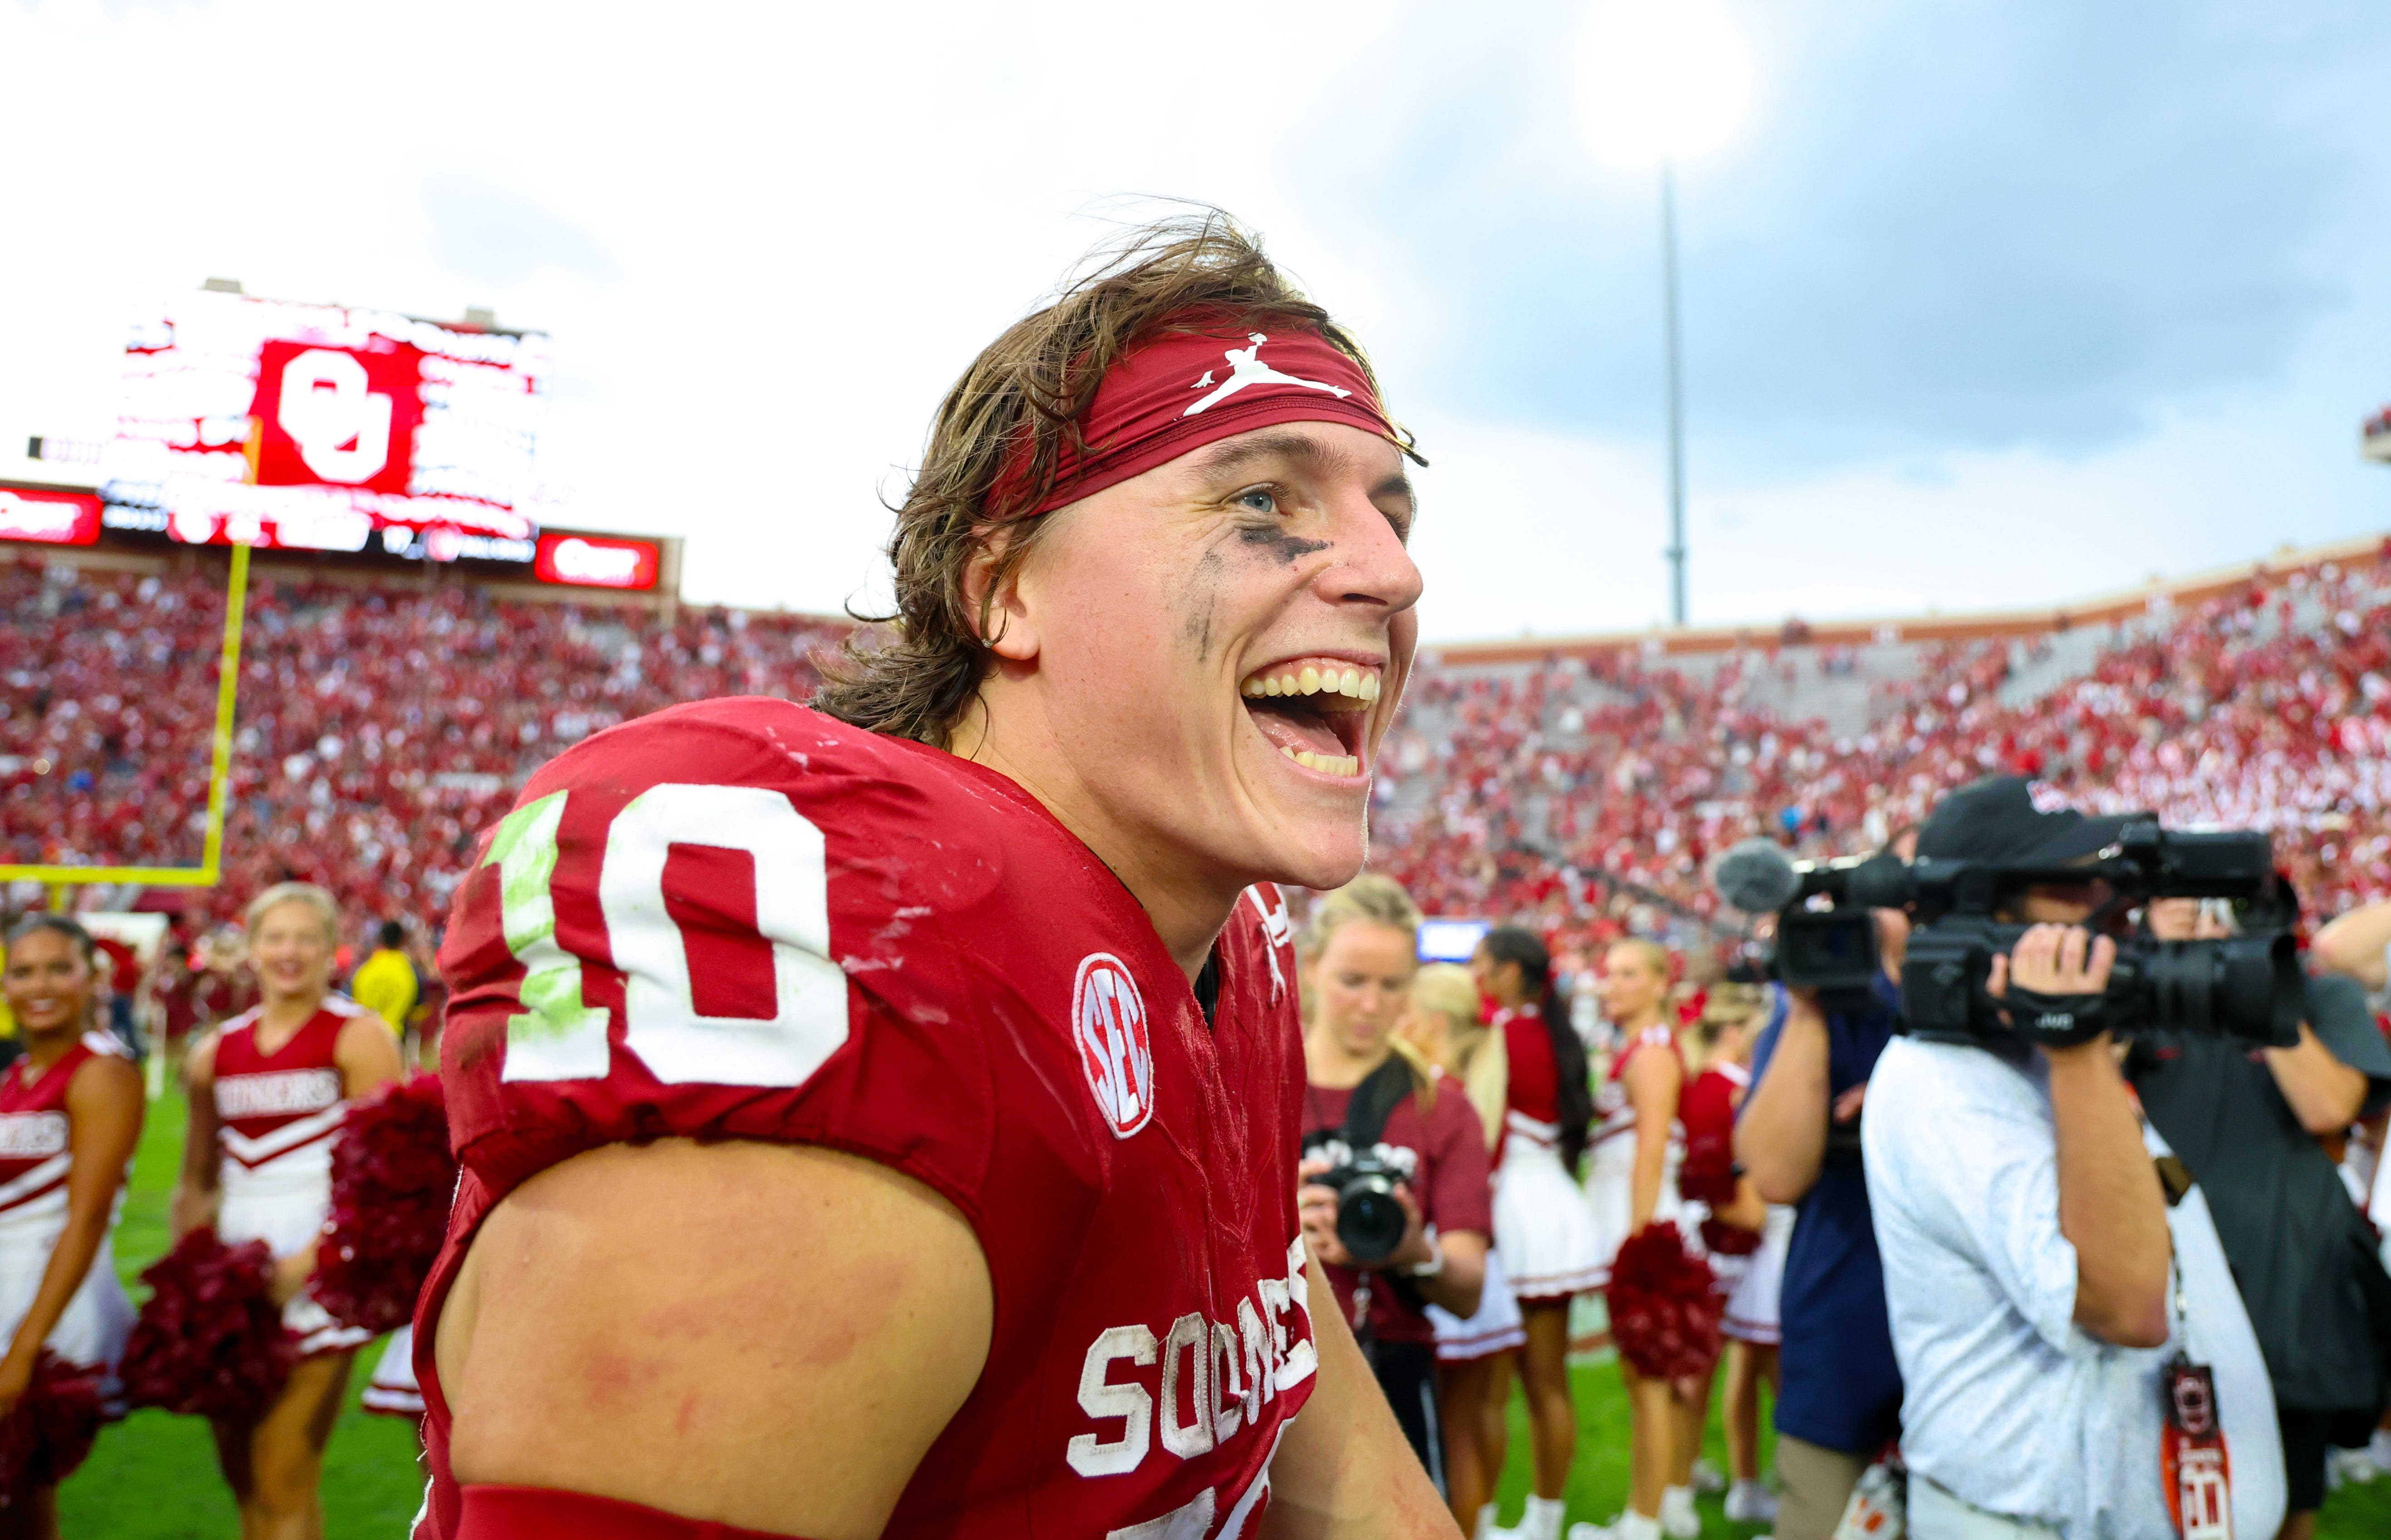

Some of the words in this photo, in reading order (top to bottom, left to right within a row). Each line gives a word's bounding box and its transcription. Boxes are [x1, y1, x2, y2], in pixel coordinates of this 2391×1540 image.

[278, 348, 393, 484] OU
[480, 782, 850, 1088] 10
[1081, 967, 1150, 1124] SEC
